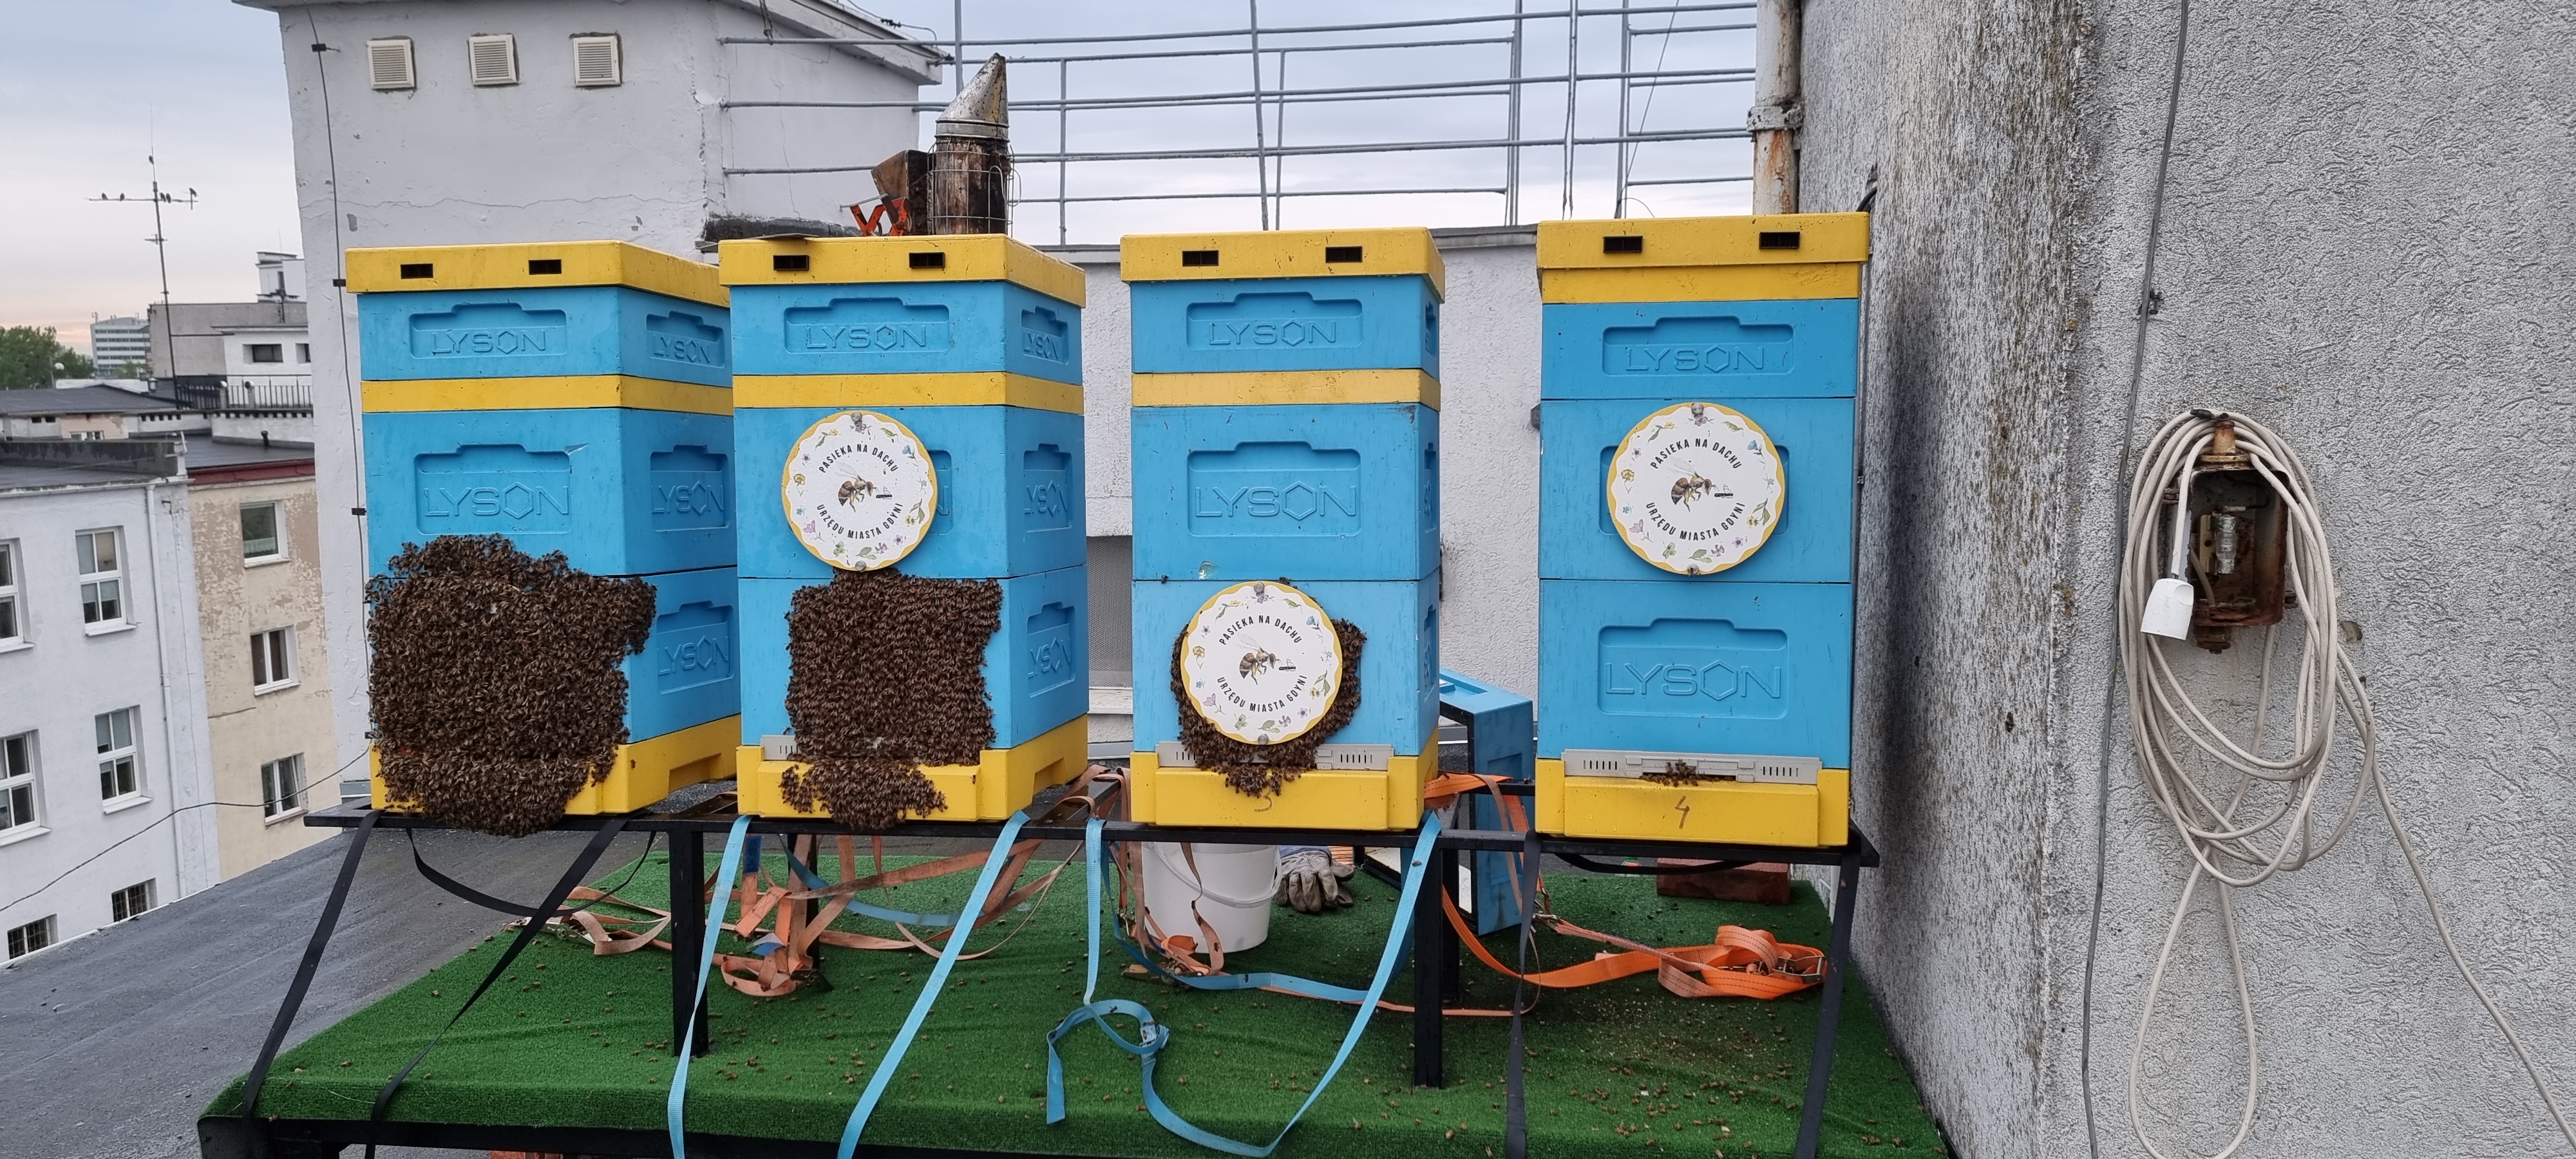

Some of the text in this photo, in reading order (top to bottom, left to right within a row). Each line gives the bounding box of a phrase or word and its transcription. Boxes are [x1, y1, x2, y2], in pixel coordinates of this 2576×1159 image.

[431, 330, 547, 355] LYSON
[652, 334, 710, 364] LYSON
[806, 324, 926, 350] LYSON
[1209, 319, 1336, 346] LYSON
[1625, 345, 1764, 372] LYSON
[819, 444, 898, 473] PASIEKA NA DACHU
[1651, 438, 1742, 469] PASIEKA NA DACHU
[424, 482, 570, 519] LYSON
[651, 481, 724, 516] LYSON
[1195, 480, 1357, 521] LYSON
[817, 503, 903, 539] URZĘDU MIASTA GDYNI
[1646, 502, 1745, 541] URZĘDU MIASTA GDYNI
[1219, 615, 1302, 645] PASIEKA NA DACHU
[658, 636, 729, 675] LYSON
[1217, 675, 1307, 712] URZĘDU MIASTA GDYNI
[1605, 659, 1781, 701] LYSON
[1675, 796, 1690, 829] 4
